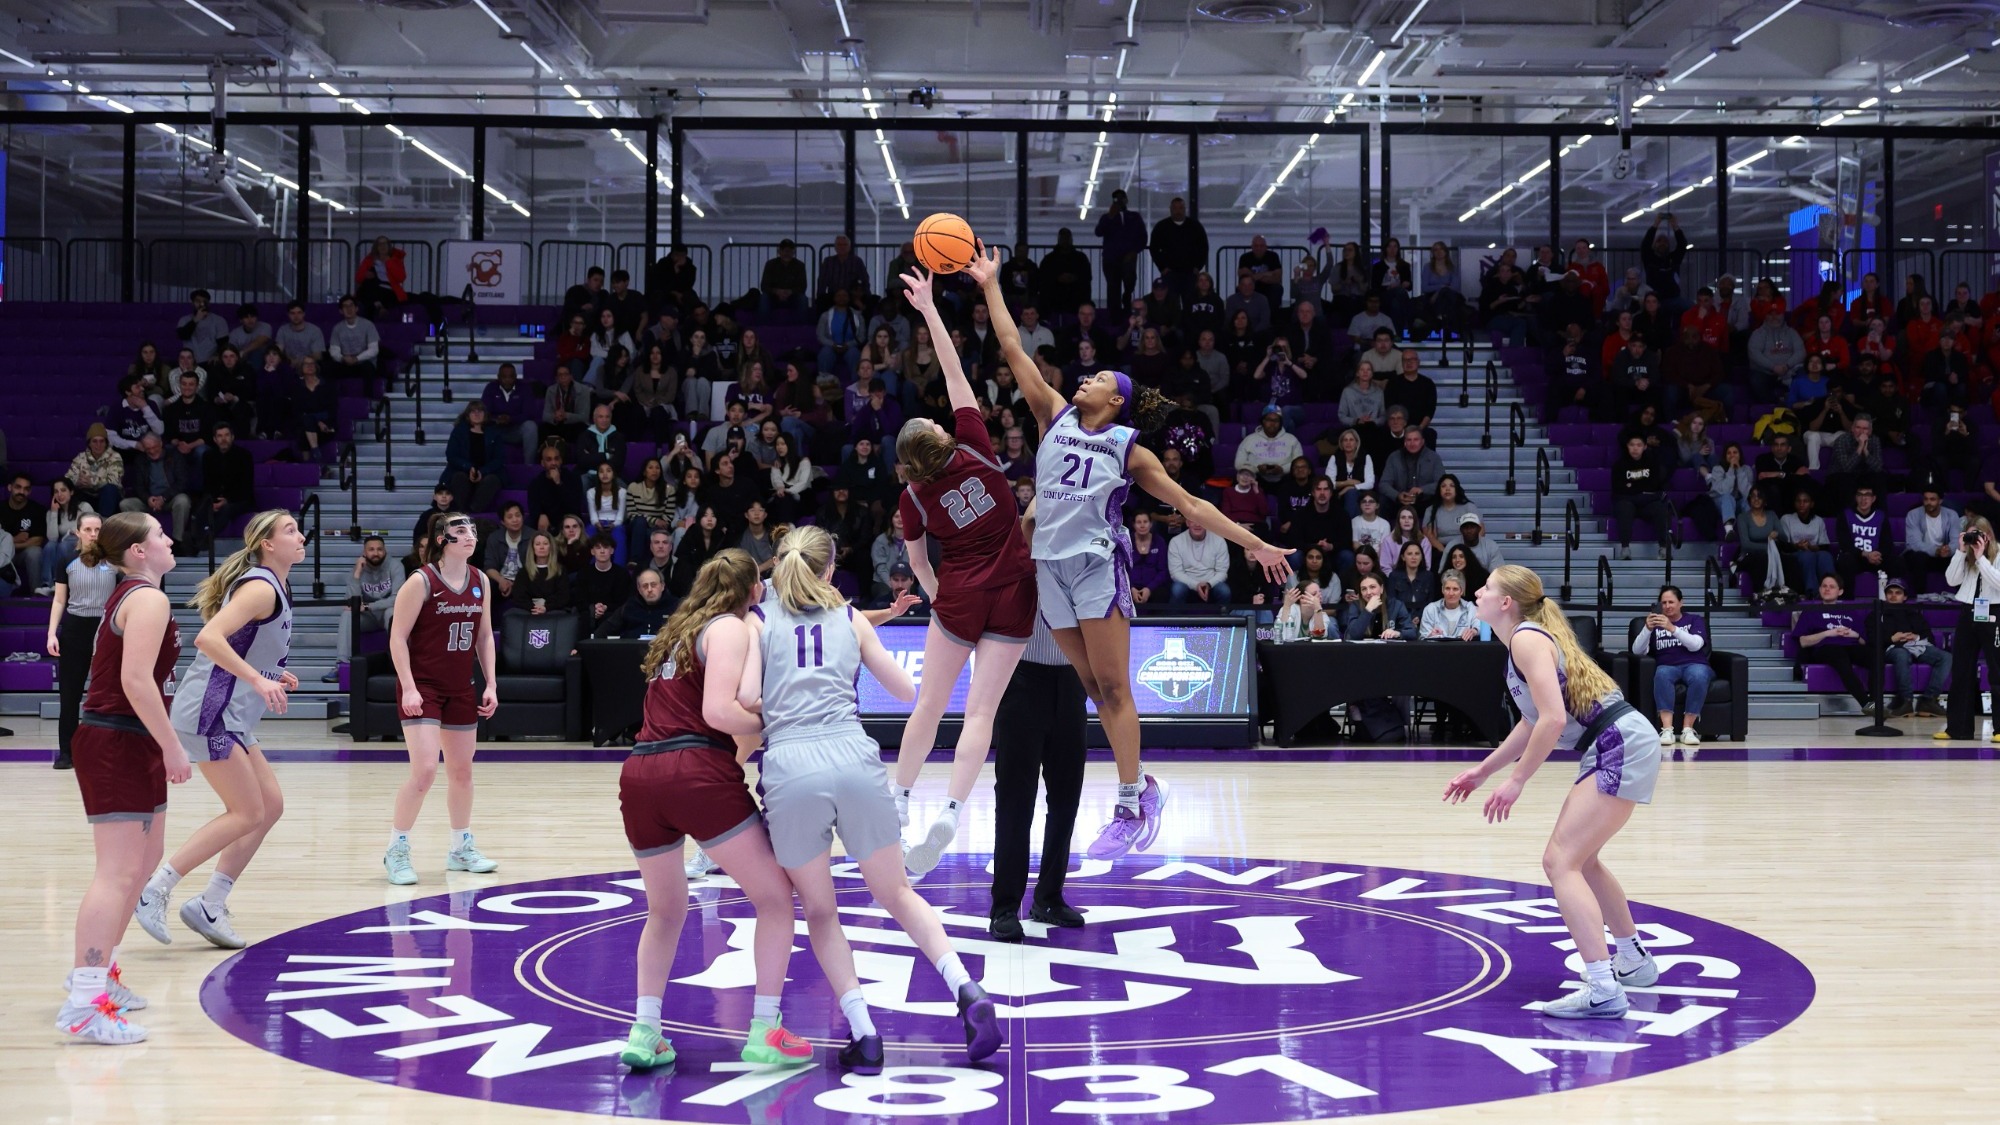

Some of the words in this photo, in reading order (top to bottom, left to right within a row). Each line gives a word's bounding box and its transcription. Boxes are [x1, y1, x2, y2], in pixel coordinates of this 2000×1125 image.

[1053, 434, 1081, 447] NEW
[1084, 441, 1116, 459] YORK
[1059, 453, 1095, 489] 21
[940, 476, 997, 529] 22
[1852, 523, 1877, 537] NYU
[1854, 536, 1873, 552] 26
[447, 622, 475, 652] 15
[794, 623, 823, 668] 11
[265, 954, 630, 1079] NEW
[682, 1054, 1380, 1116] 1831
